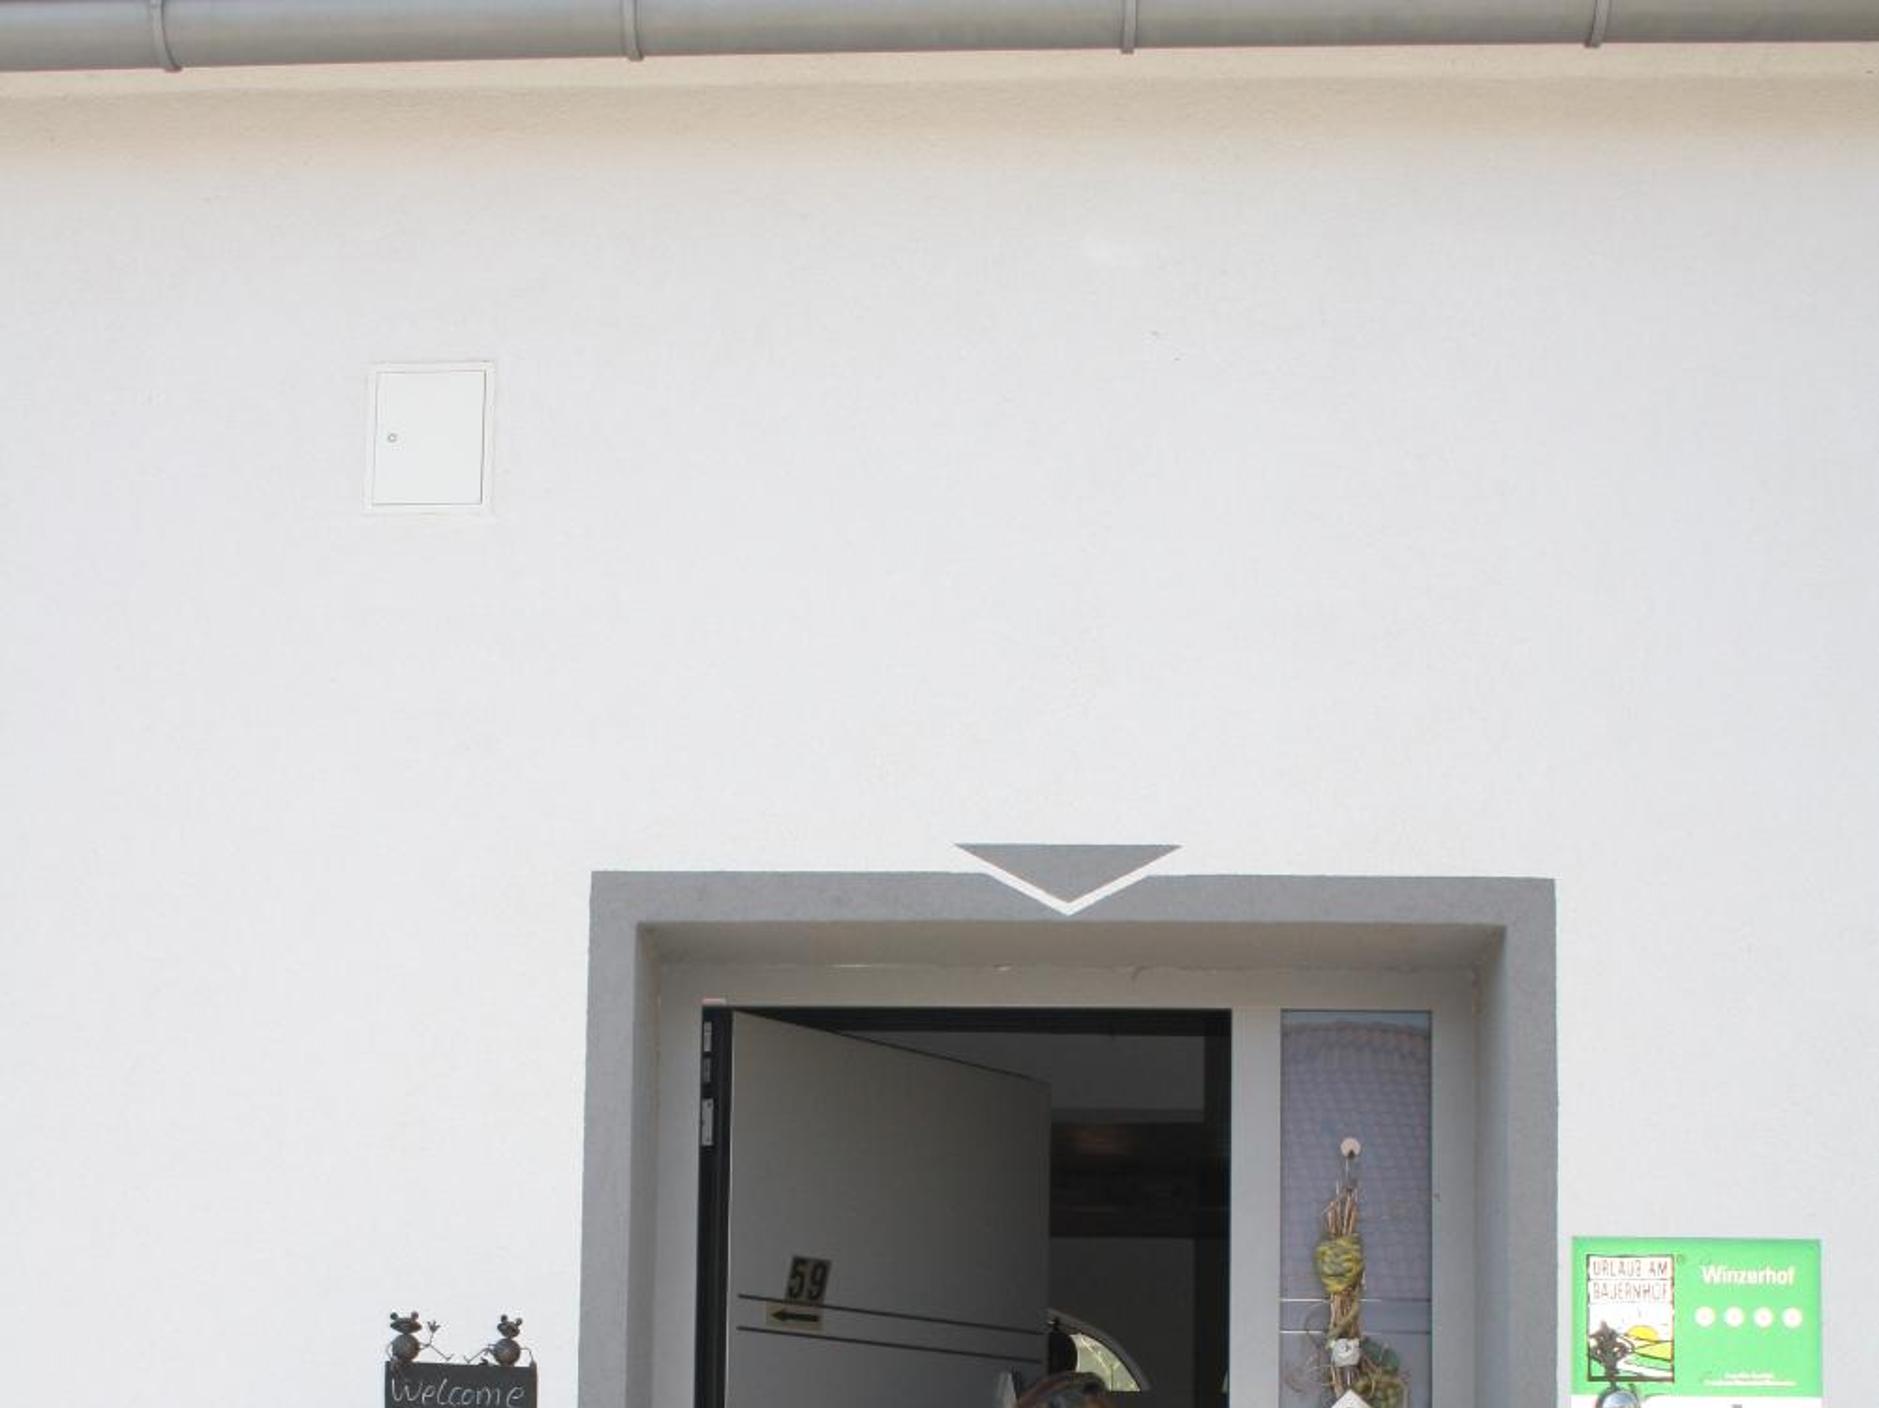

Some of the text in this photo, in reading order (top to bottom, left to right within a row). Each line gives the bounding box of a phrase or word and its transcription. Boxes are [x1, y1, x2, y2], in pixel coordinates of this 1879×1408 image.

[788, 1256, 828, 1301] 59
[1593, 1259, 1668, 1277] URLAUB AM
[1699, 1264, 1796, 1286] Winzerhof
[1592, 1281, 1667, 1301] BAUERNHOF
[391, 1377, 525, 1408] Welcome
